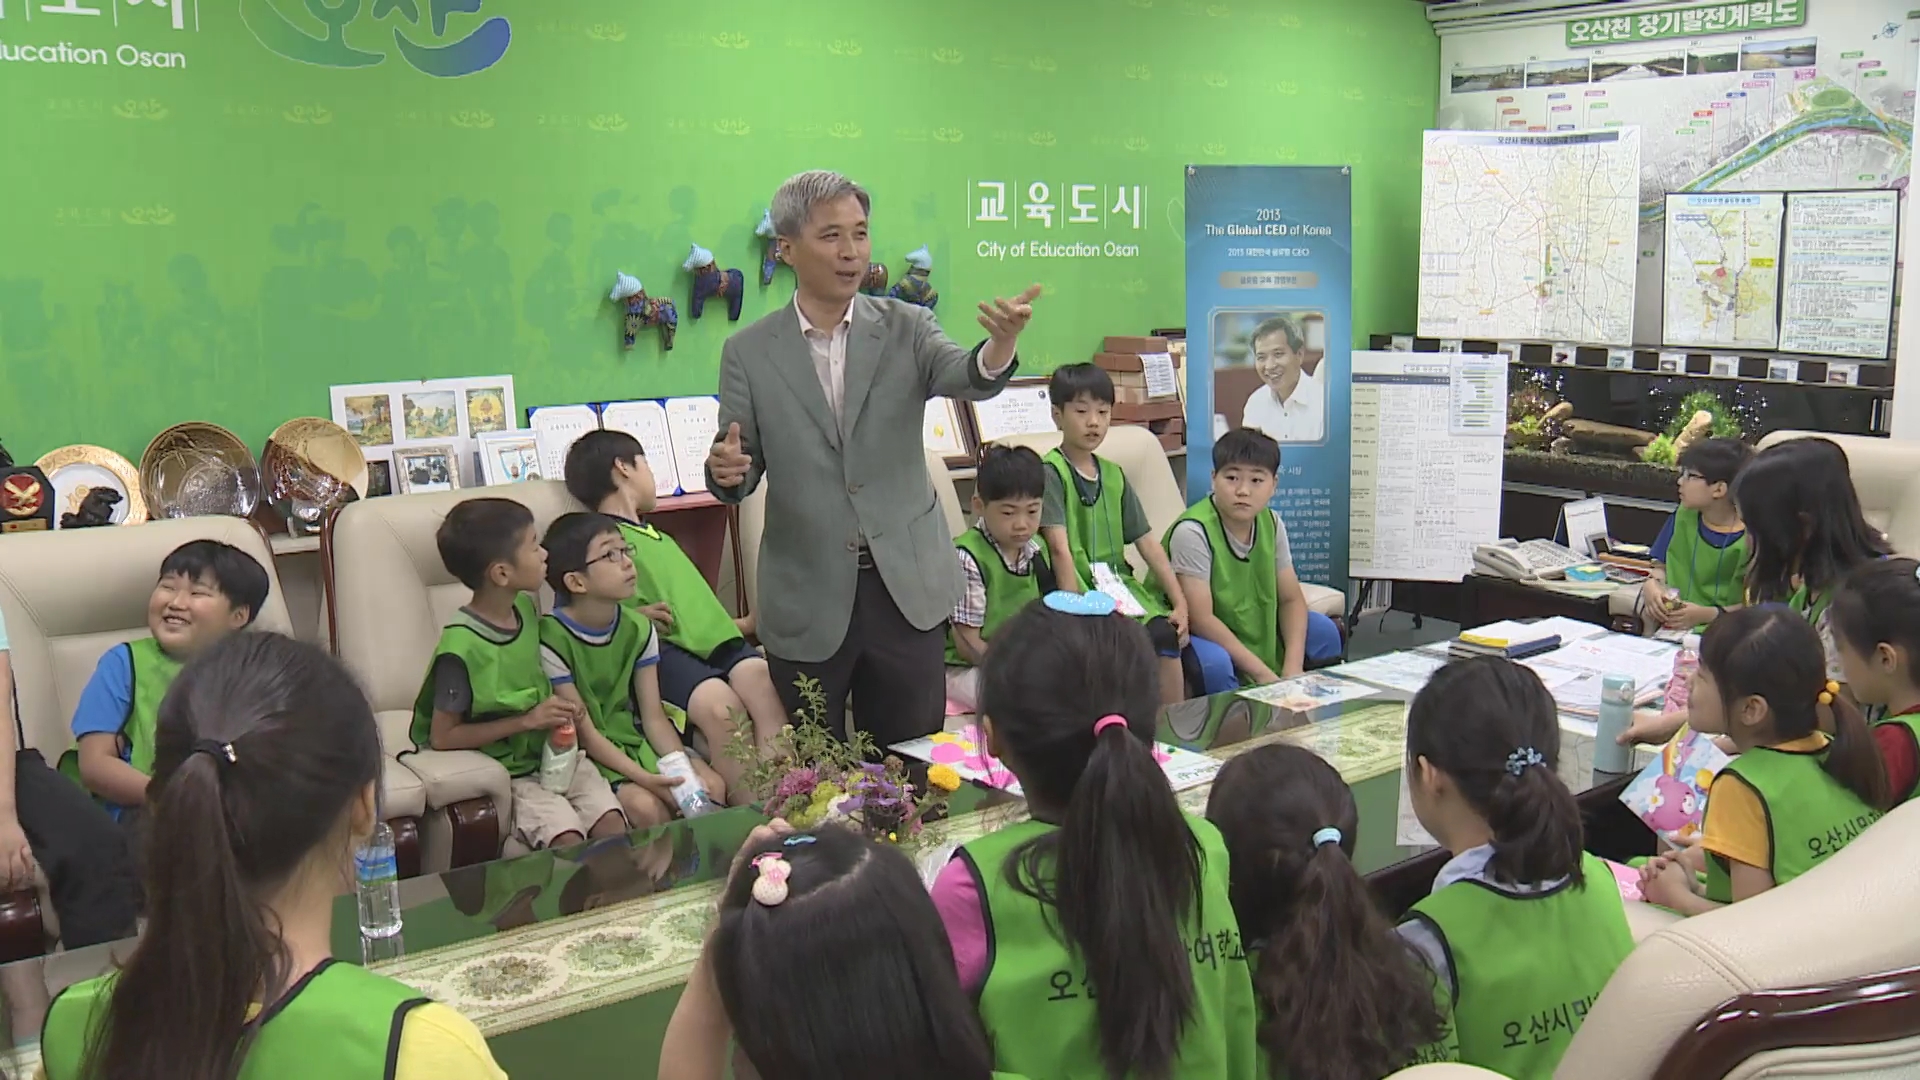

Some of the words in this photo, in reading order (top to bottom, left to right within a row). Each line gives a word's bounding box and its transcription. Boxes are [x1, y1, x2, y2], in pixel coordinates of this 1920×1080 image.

[1571, 16, 1631, 42] 오산천
[1638, 0, 1798, 37] 장기발전계획도
[116, 44, 186, 68] Osan
[976, 181, 1140, 229] 교육도시
[1256, 208, 1281, 221] 2013
[1205, 224, 1225, 236] The
[1227, 224, 1262, 236] Global
[1264, 224, 1287, 236] CEO
[1290, 224, 1300, 236] of
[1303, 224, 1332, 236] Korea
[977, 240, 1006, 261] City
[1010, 240, 1025, 257] of
[1030, 240, 1100, 257] Education
[1104, 241, 1139, 257] Osan
[1228, 248, 1244, 257] 2013
[1503, 991, 1600, 1048] 오산시민
